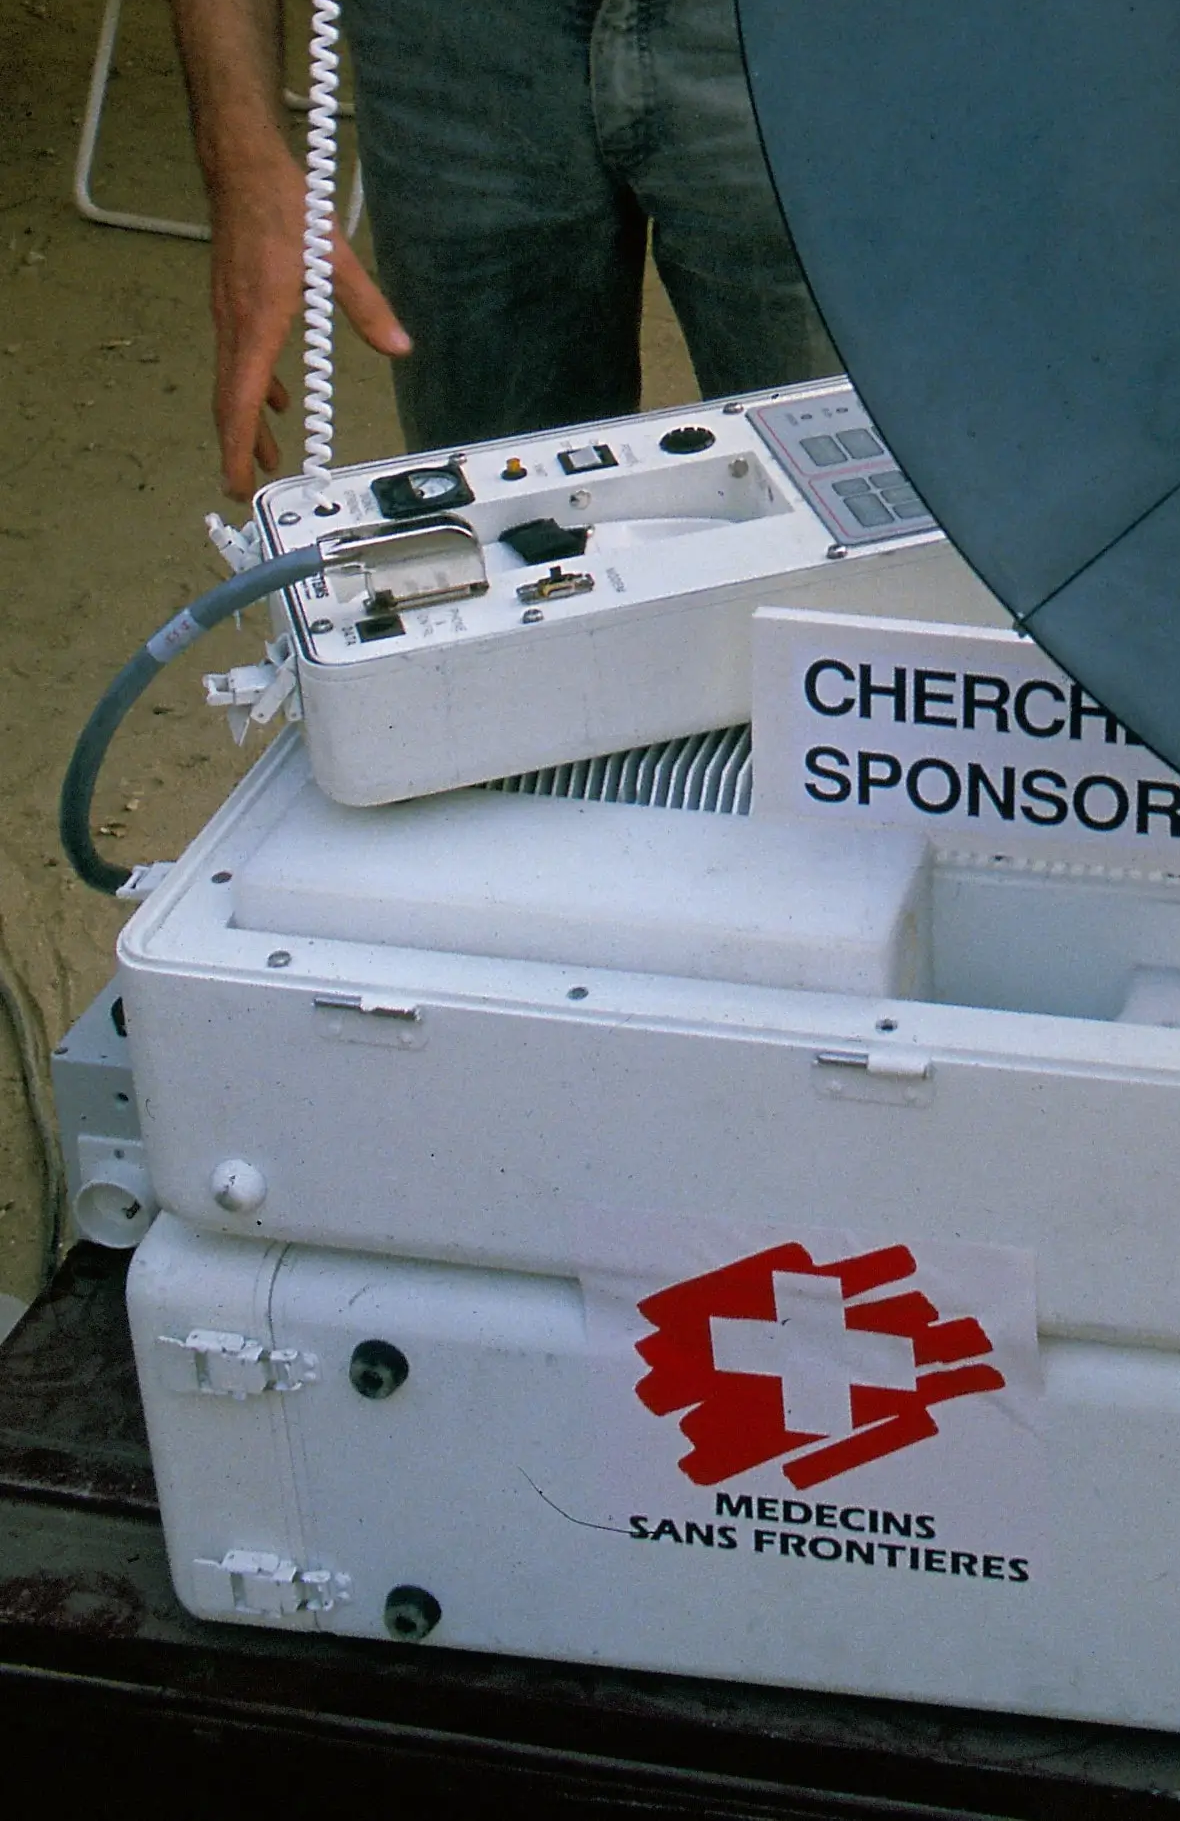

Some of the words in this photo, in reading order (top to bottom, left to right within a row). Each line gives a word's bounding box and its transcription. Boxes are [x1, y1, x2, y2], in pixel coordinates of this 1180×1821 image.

[804, 658, 1147, 746] CHERCH
[628, 1514, 738, 1549] SANS
[753, 1528, 1030, 1582] FRONTIERES
[715, 1492, 937, 1540] MEDECINS
